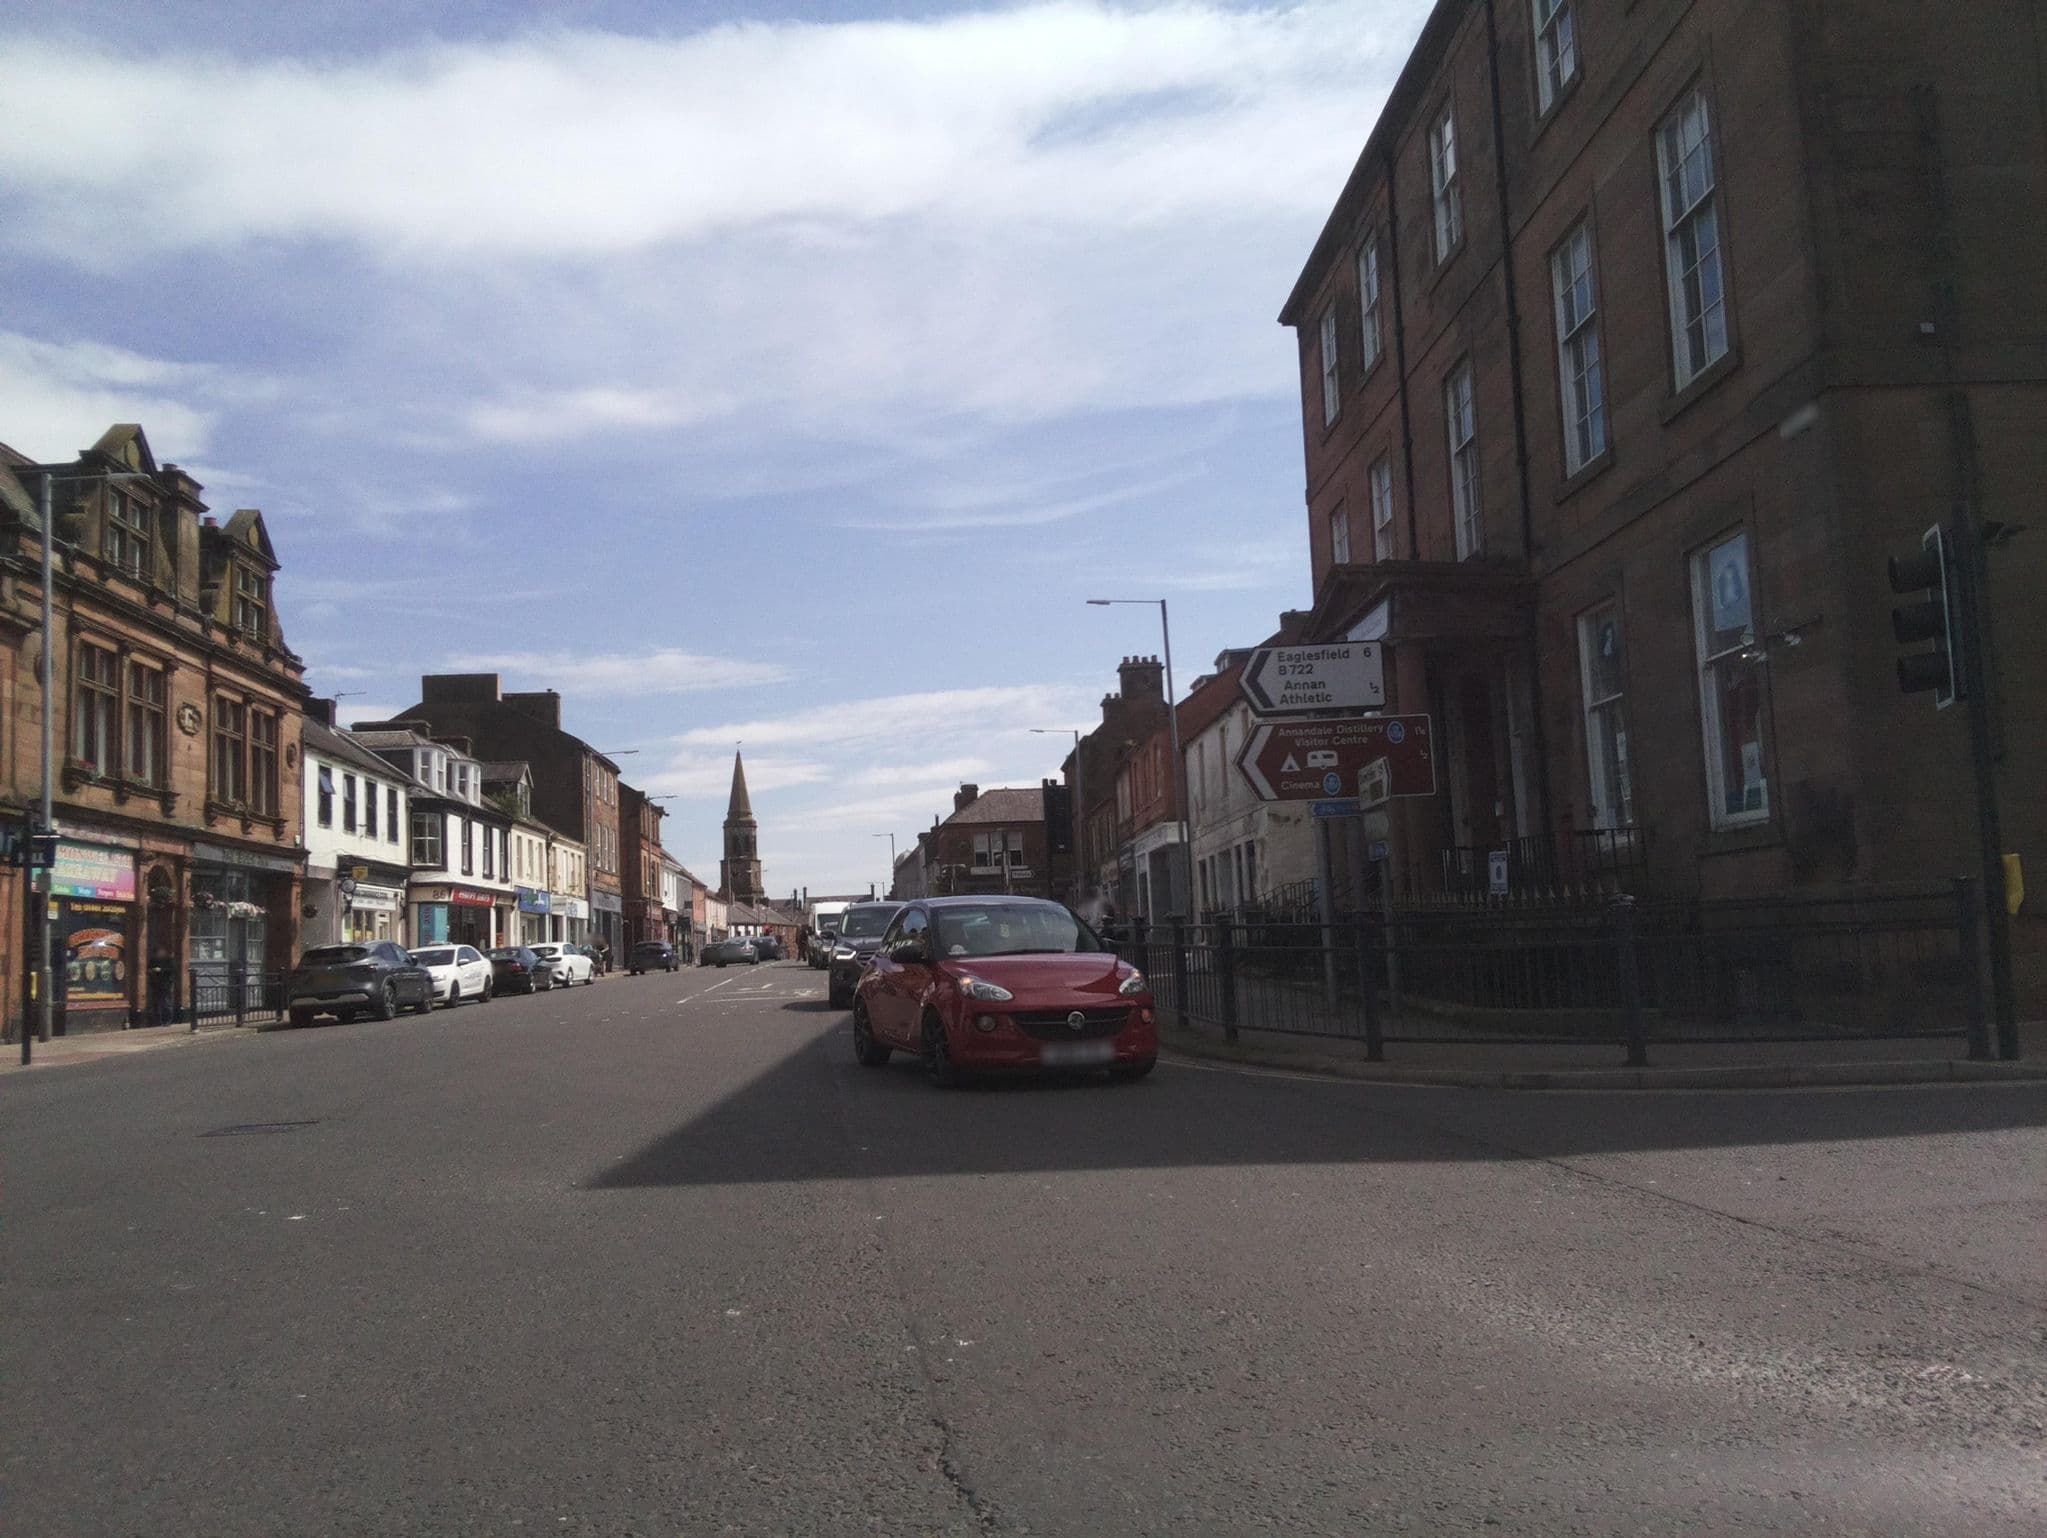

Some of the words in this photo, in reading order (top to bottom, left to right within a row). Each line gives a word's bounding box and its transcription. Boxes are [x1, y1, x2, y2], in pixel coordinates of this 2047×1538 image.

[1278, 648, 1350, 663] Eaglesfield
[1363, 647, 1372, 658] 6
[1284, 681, 1326, 690] Annan
[1280, 693, 1333, 705] Athletic
[1279, 727, 1333, 737] Annandale
[1337, 724, 1384, 734] Distillery
[1295, 737, 1329, 747] Visitor
[1333, 735, 1369, 745] Centre
[1281, 781, 1320, 791] Cinema
